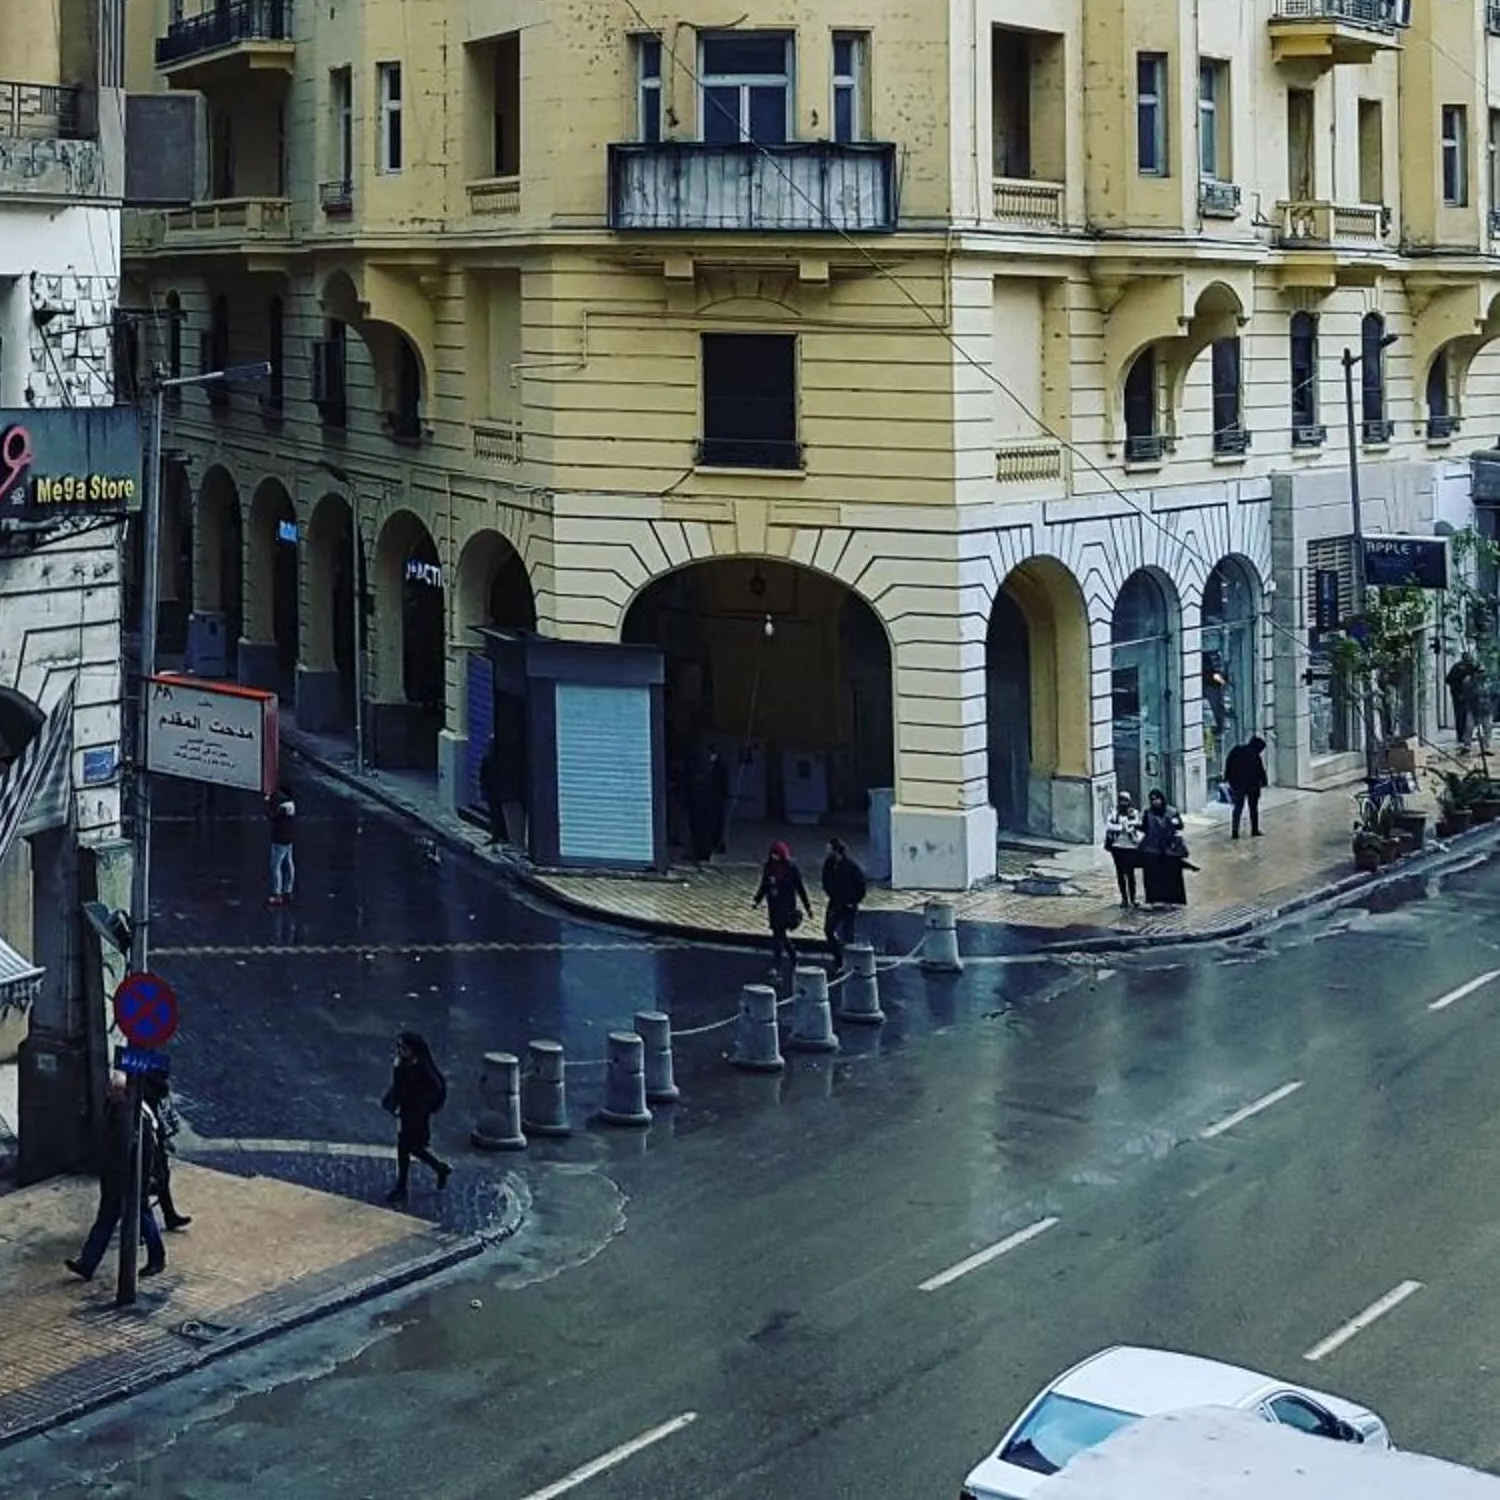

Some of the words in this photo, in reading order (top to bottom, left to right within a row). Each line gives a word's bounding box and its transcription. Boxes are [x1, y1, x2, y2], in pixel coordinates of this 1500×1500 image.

[36, 476, 86, 503] Mega
[89, 474, 135, 499] Store
[1366, 541, 1411, 555] APPLE
